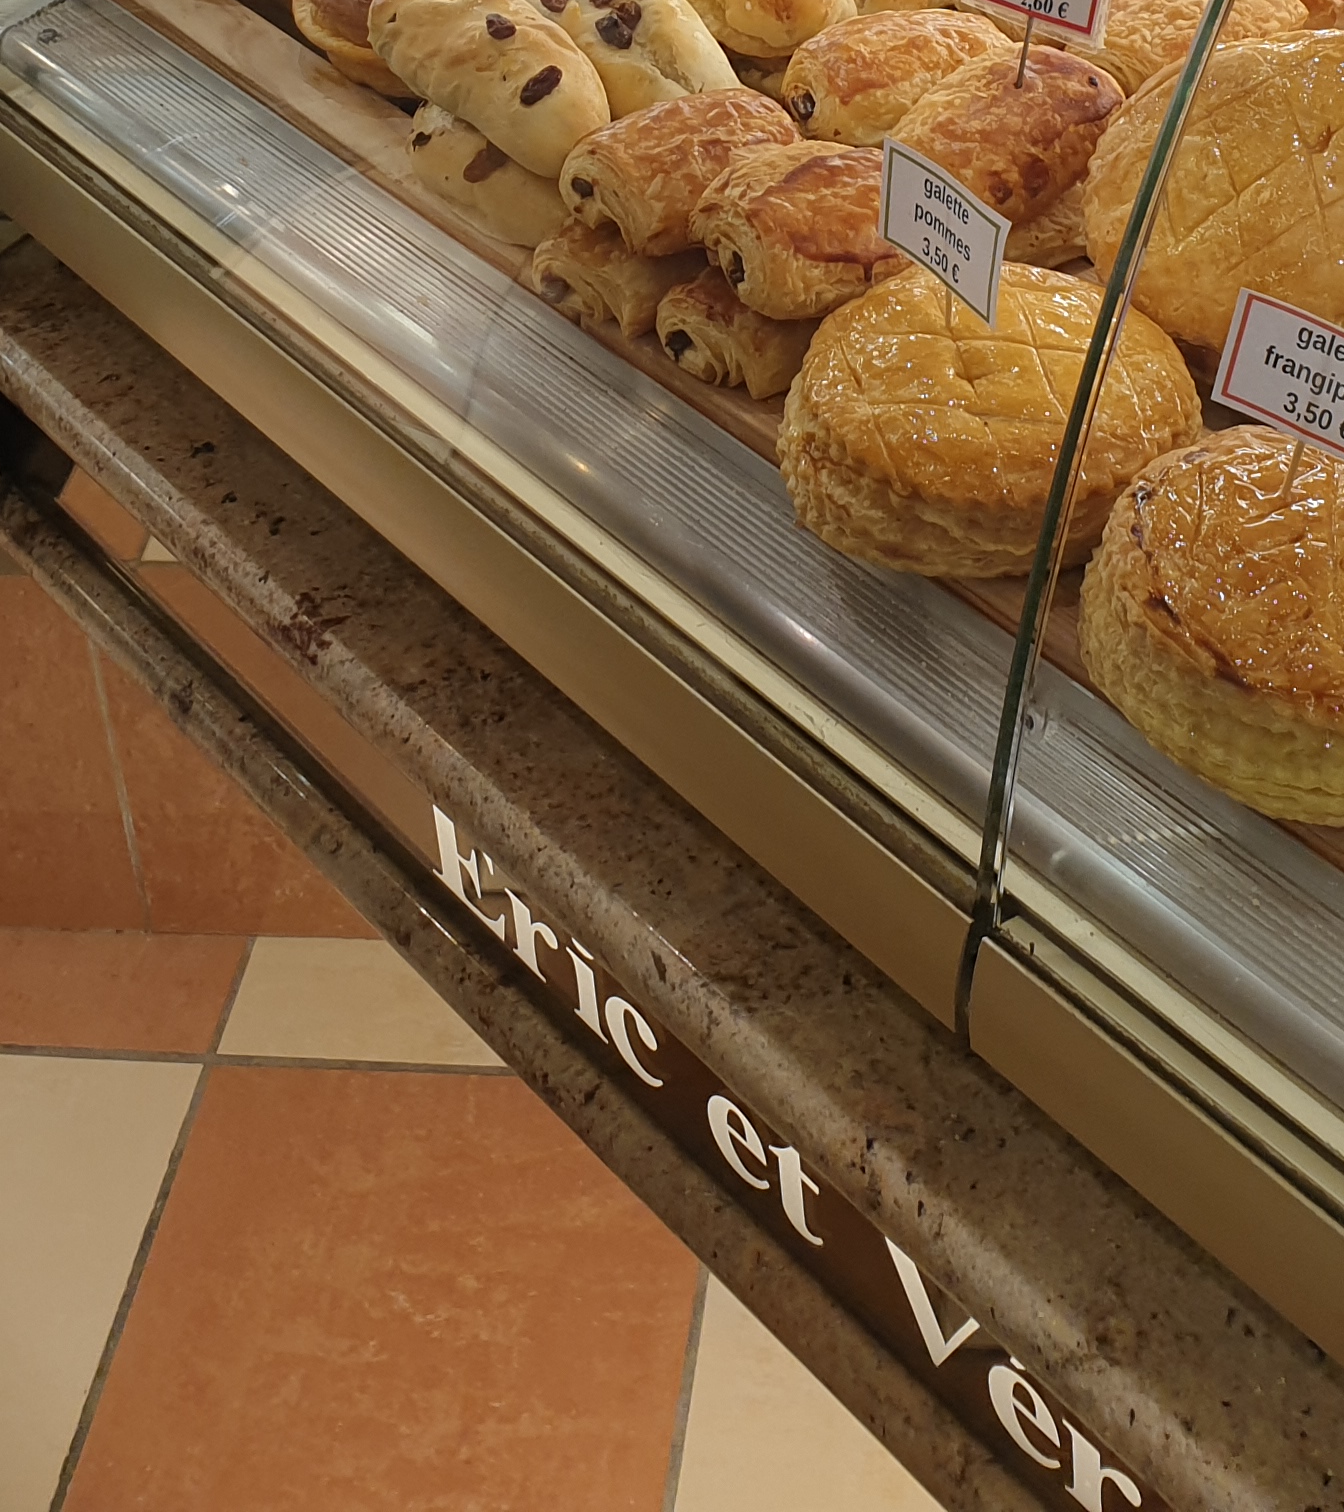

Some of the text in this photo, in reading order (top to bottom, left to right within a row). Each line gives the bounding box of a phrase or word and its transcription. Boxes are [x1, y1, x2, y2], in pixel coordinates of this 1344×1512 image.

[1058, 2, 1069, 19] €
[924, 178, 969, 225] galette
[914, 202, 971, 261] pommes
[922, 237, 960, 284] 3,50 €
[1283, 392, 1332, 430] 3,50
[431, 804, 664, 1087] Eric
[707, 1094, 824, 1245] et
